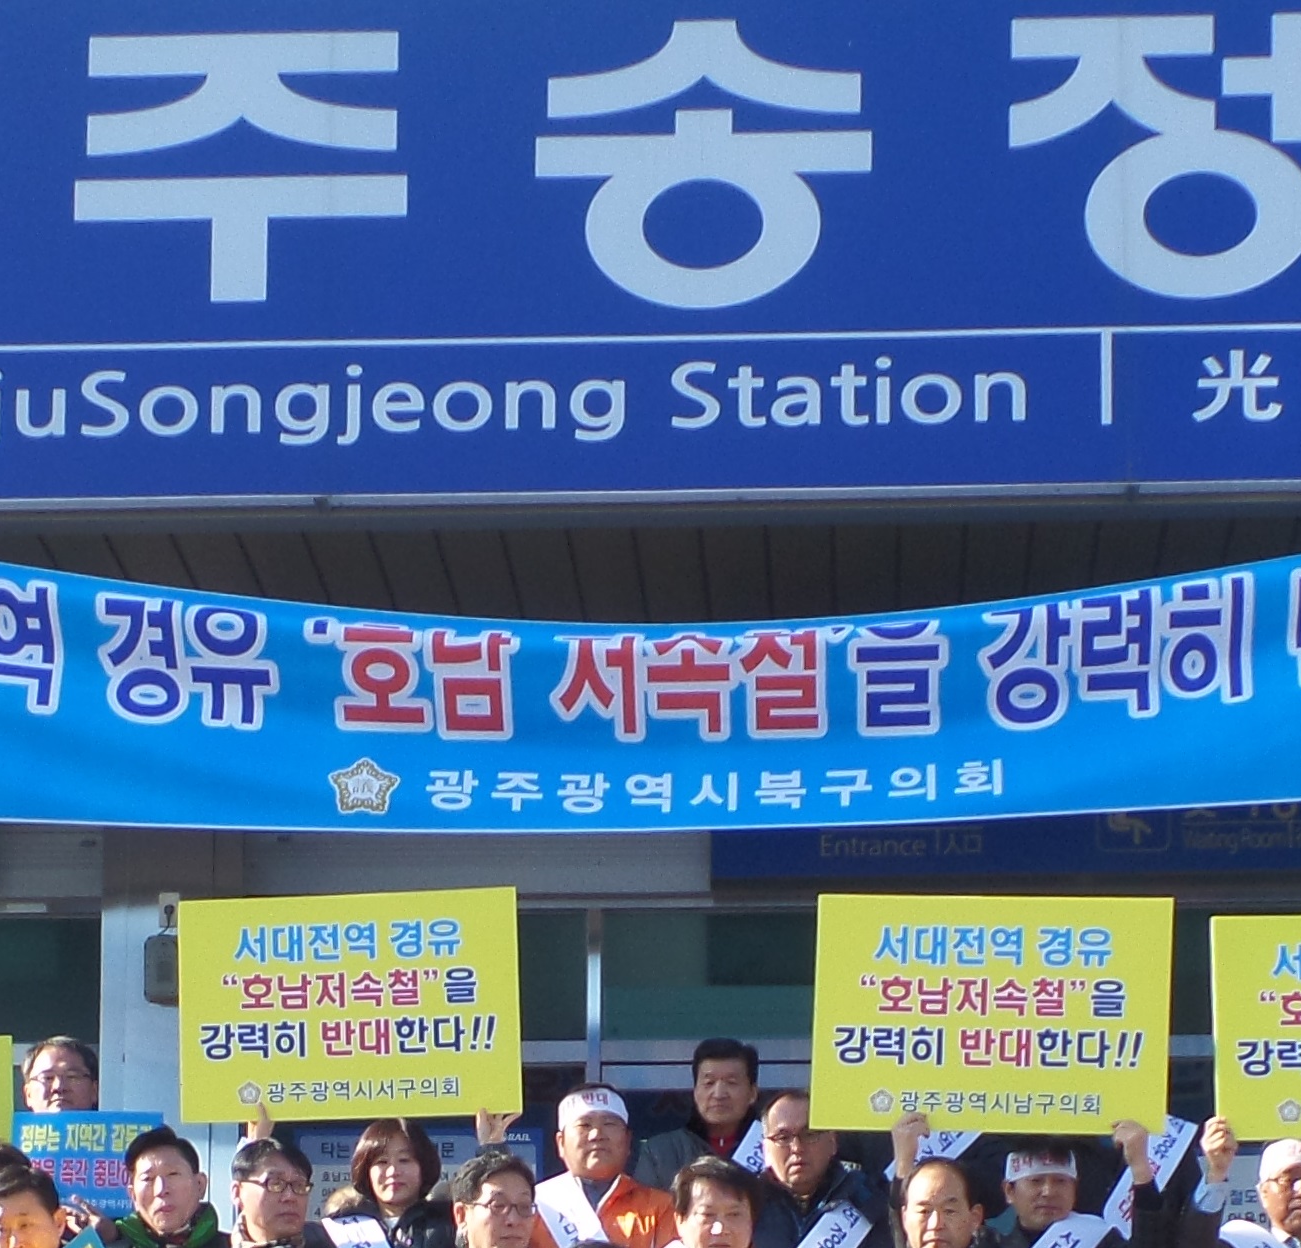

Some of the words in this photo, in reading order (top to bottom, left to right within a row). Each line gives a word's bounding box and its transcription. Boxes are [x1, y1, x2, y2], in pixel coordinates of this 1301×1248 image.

[670, 356, 1027, 431] Station
[100, 593, 277, 728] 경유
[980, 573, 1253, 729] 강력히
[426, 759, 1004, 814] 광주광역시북구의회
[819, 835, 927, 857] Entrance
[944, 834, 984, 855] 入口
[234, 922, 376, 963] 서대전역
[389, 921, 461, 960] 경유
[875, 927, 1024, 965] 서대전역
[1037, 927, 1111, 966] 경유
[200, 1022, 308, 1060] 강력히
[320, 1015, 496, 1057] 반대한다!!
[834, 1026, 945, 1065] 강력히
[958, 1029, 1142, 1069] 반대한다!!
[266, 1076, 461, 1102] 광주광역시서구의회
[899, 1090, 1102, 1115] 광주광역시남구의회
[20, 1124, 59, 1152] 정부는
[65, 1124, 108, 1150] 지역간
